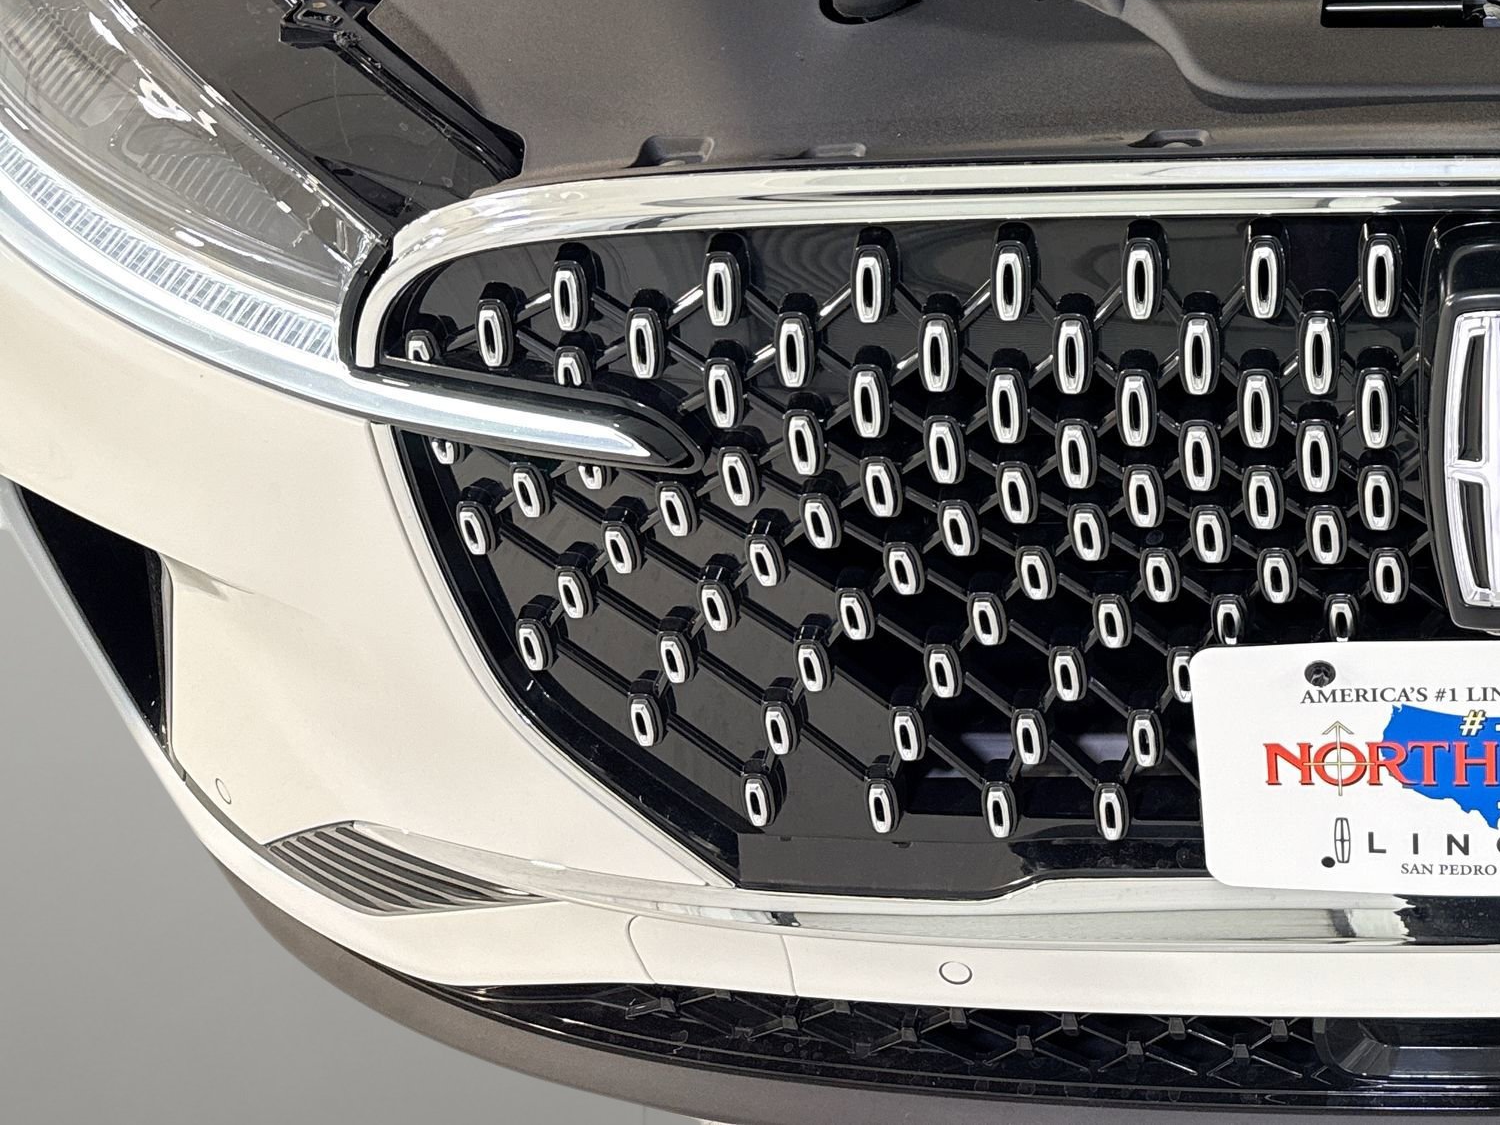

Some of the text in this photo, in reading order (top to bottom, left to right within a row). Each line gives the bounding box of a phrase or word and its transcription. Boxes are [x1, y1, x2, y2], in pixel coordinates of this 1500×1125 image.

[1300, 685, 1428, 704] AMERICA'S
[1434, 687, 1459, 702] #1
[1263, 739, 1500, 787] NORTH
[1401, 863, 1433, 876] SAN
[1440, 863, 1497, 876] PEDRO
